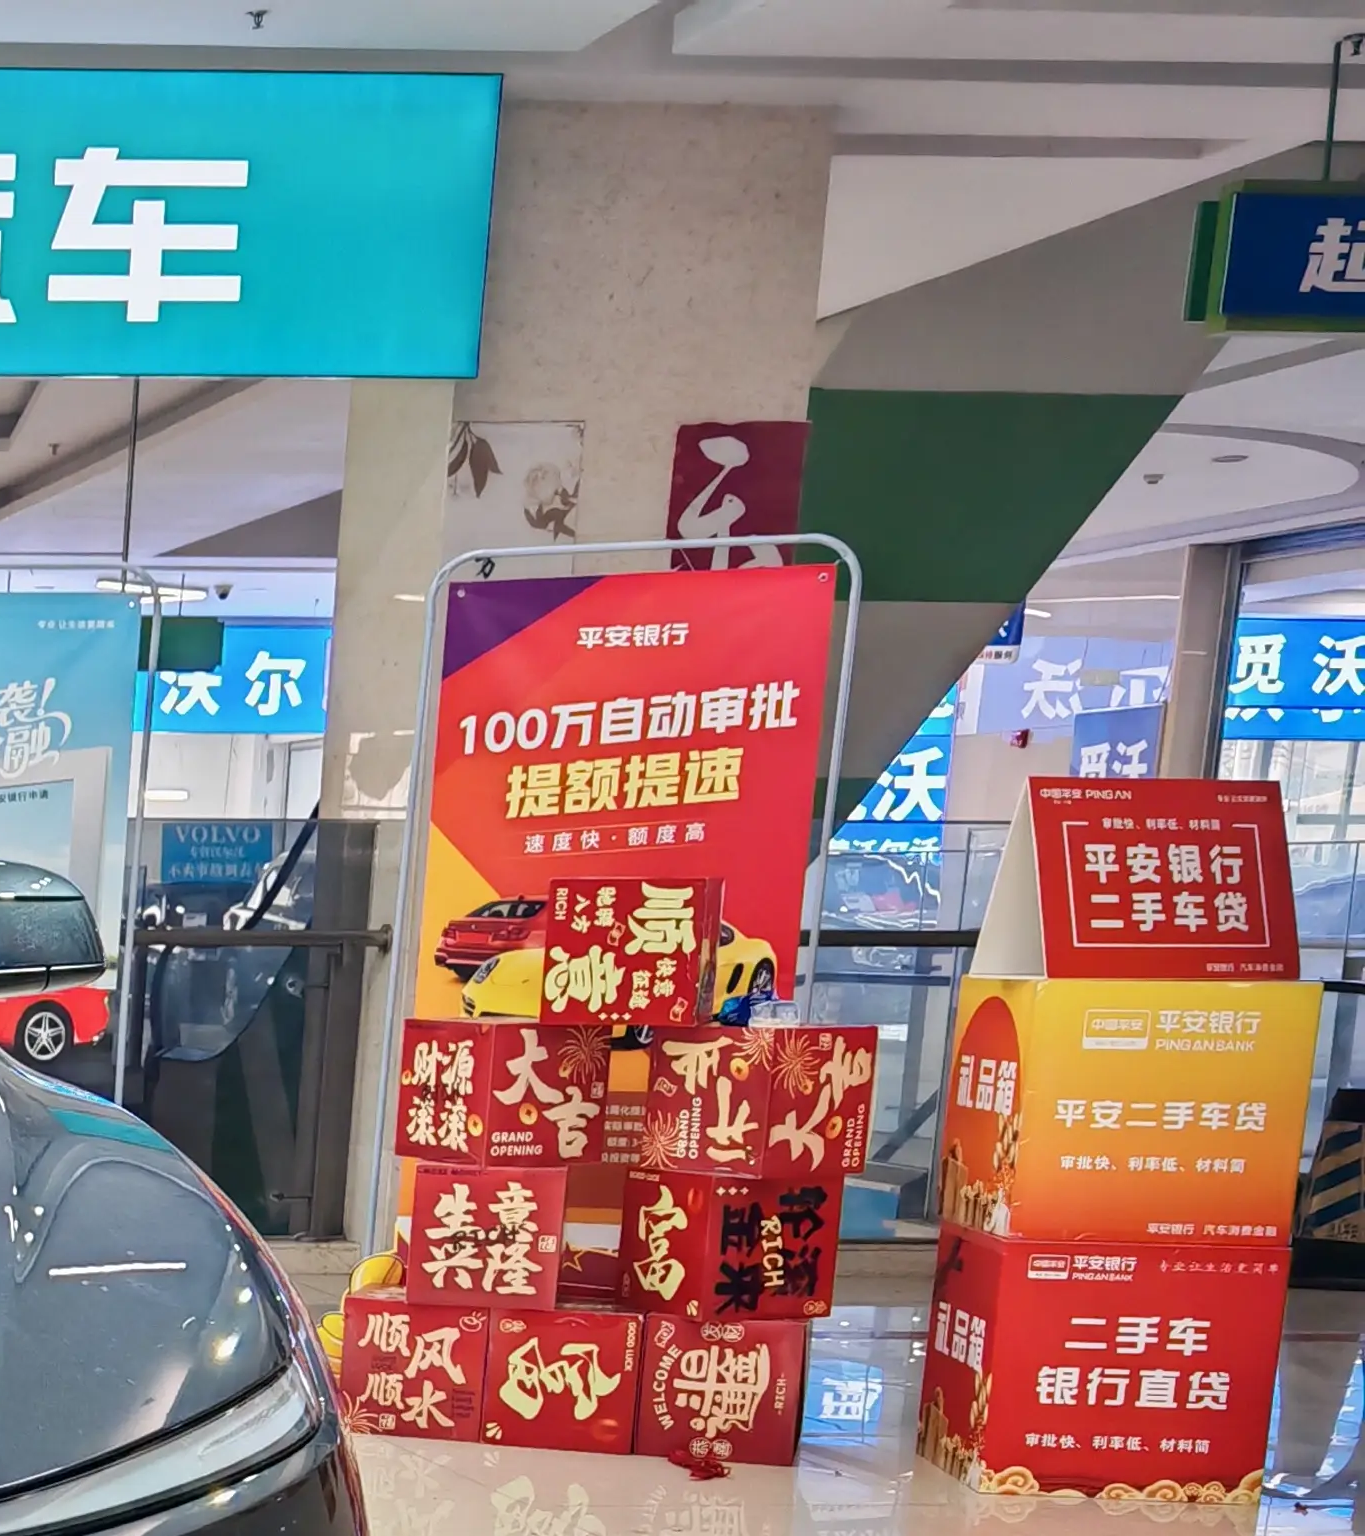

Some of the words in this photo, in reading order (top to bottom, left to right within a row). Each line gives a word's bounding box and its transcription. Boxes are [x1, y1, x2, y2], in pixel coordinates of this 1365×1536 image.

[576, 622, 689, 649] 平安银行
[458, 680, 801, 757] 100万自动审批
[505, 747, 744, 820] 提额提速
[176, 825, 260, 843] VOLVO
[1084, 843, 1243, 885] 平安银行
[554, 887, 568, 920] RICH
[571, 894, 591, 933] 八方
[1090, 891, 1249, 932] 二手车贷
[1155, 1010, 1262, 1035] 平安银行
[412, 1040, 474, 1095] 财源
[956, 1055, 1018, 1116] 礼品箱
[493, 1028, 600, 1160] 大吉
[1054, 1099, 1268, 1132] 平安二手车贷
[406, 1096, 469, 1152] 滚滚
[492, 1132, 534, 1143] GRAND
[677, 1109, 690, 1158] GRAND
[689, 1097, 702, 1159] OPENING
[841, 1118, 855, 1168] GRAND
[851, 1103, 865, 1167] OPENING
[490, 1145, 543, 1157] OPENING
[1060, 1155, 1246, 1174] 审批快、利率低、材料简
[425, 1181, 539, 1243] 生意
[633, 1185, 687, 1301] 富
[761, 1216, 784, 1287] RICH
[1072, 1256, 1137, 1272] 平安银行
[422, 1243, 543, 1296] 兴隆
[358, 1312, 466, 1385] 顺风
[935, 1300, 987, 1374] 礼品箱
[1064, 1316, 1212, 1356] 二手车
[356, 1372, 455, 1428] 顺水
[652, 1344, 683, 1430] WELCOME
[1036, 1365, 1231, 1411] 银行直贷
[1025, 1432, 1210, 1454] 审批快、利率低、材料简
